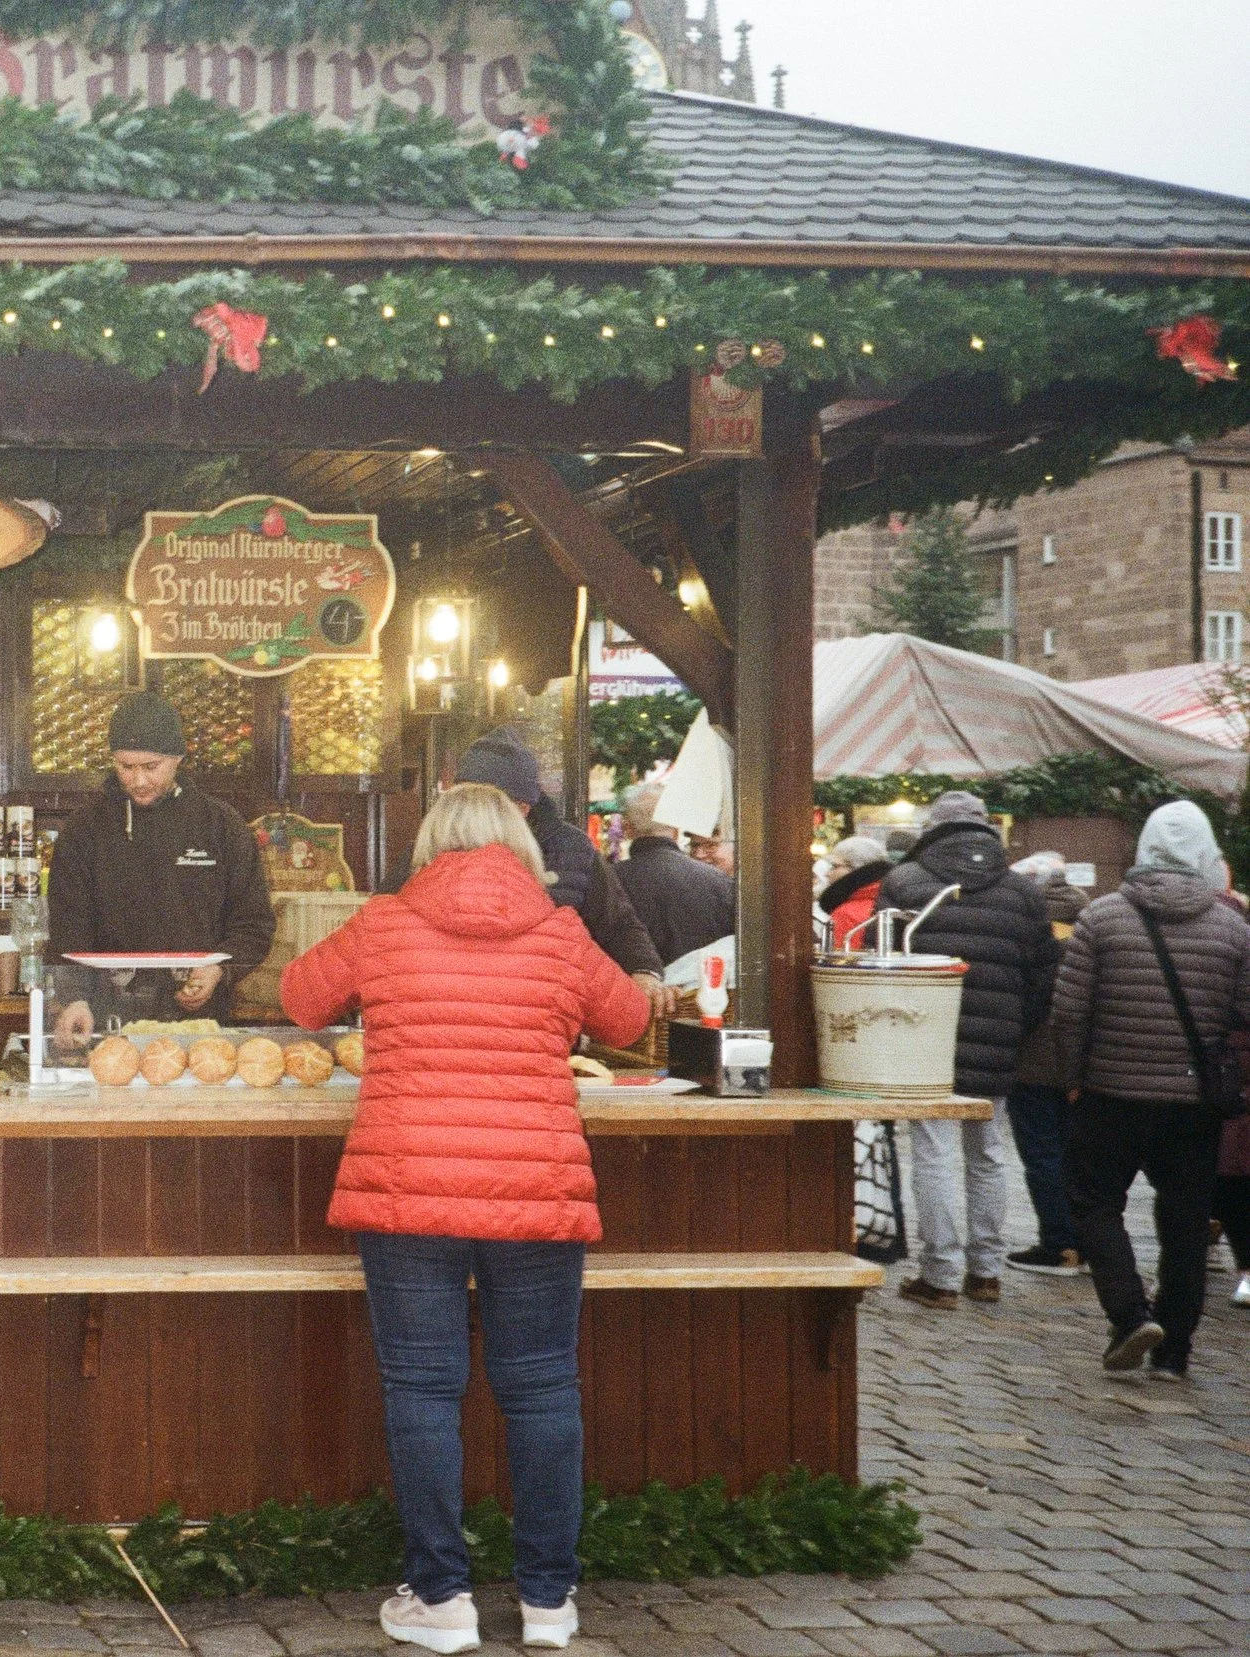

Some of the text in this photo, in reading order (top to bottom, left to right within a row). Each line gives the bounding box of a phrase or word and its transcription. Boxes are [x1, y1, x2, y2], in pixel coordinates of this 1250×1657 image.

[165, 531, 345, 564] Original Nürnberger
[147, 563, 309, 606] Bratwürste
[181, 614, 202, 640] im
[204, 612, 283, 646] Brötchen
